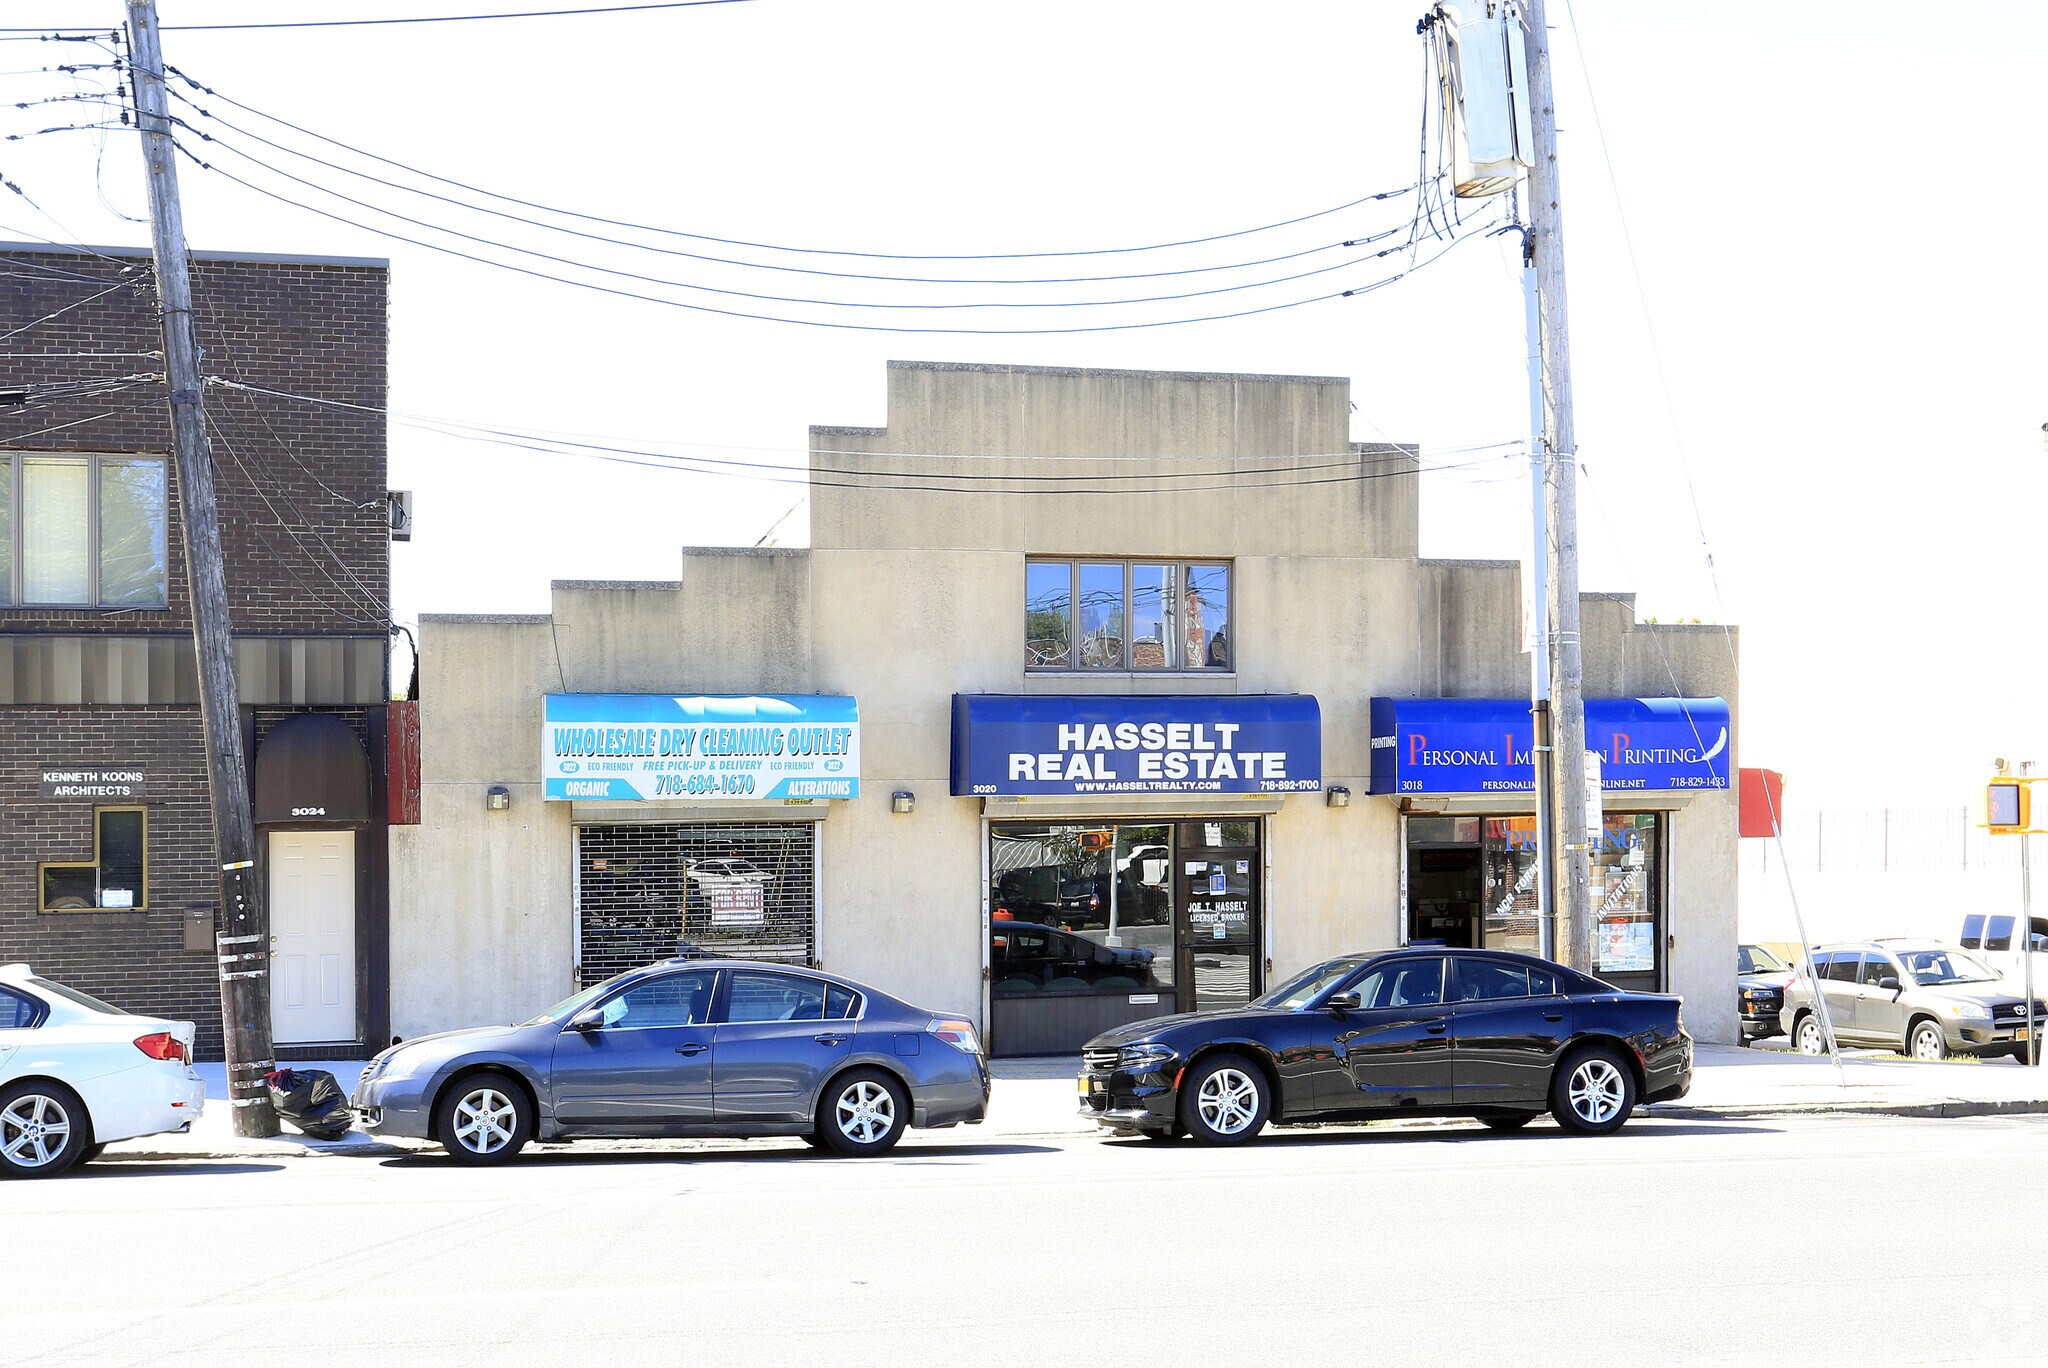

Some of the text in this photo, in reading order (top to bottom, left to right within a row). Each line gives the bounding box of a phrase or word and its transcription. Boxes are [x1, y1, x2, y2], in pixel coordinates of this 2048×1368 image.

[1058, 722, 1240, 751] HASSELT
[554, 727, 852, 758] WHOLESALE DRY CLEANING OUTLET
[1371, 735, 1397, 750] PRINTING
[1407, 733, 1499, 766] PERSONAL
[1611, 733, 1698, 764] PRINTING
[588, 762, 634, 772] ECO FRIENDLY
[643, 760, 763, 771] FREE PICK-UP & DELIVERY
[770, 761, 815, 771] ECO FRIENDLY
[1008, 751, 1287, 781] REAL ESTATE
[43, 772, 144, 783] KENNETH KOONS
[565, 780, 611, 798] ORGANIC
[655, 773, 756, 796] 718-684-1670
[787, 780, 851, 796] ALTERATIONS
[972, 784, 997, 794] 3020
[1074, 781, 1221, 792] WWW.HASSELTREALTY.COM
[1259, 779, 1320, 791] 718-892-1700
[1401, 780, 1423, 791] 3018
[53, 785, 131, 796] ARCHITECTS
[291, 807, 326, 817] 3024
[1495, 858, 1539, 917] NCR FORM
[1596, 865, 1643, 922] INVITATIONS
[1188, 901, 1247, 912] JOE T. HASSELT
[1190, 913, 1245, 922] LICENSED BROKER
